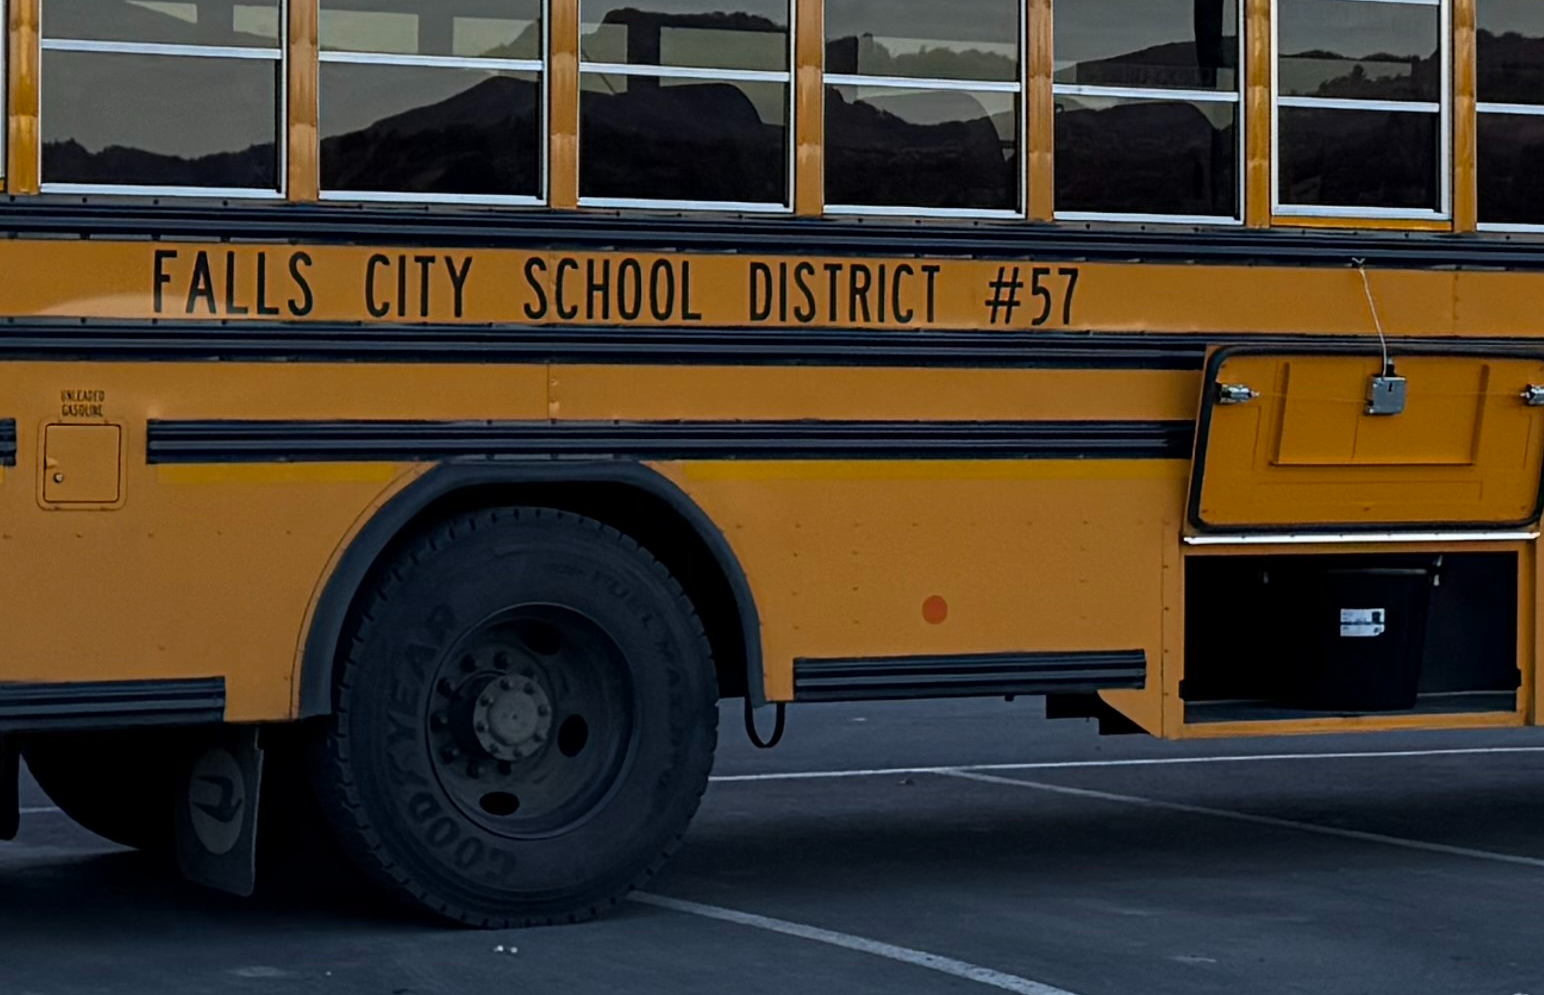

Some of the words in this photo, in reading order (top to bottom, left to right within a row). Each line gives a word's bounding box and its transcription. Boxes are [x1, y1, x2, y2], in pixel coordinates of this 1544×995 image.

[153, 248, 314, 317] FALLS
[364, 252, 473, 319] CITY
[523, 256, 702, 322] SCHOOL
[748, 261, 940, 323] DISTRICT
[984, 265, 1079, 326] #57
[60, 389, 105, 402] UNLEADED
[61, 403, 103, 417] GASOLINE
[385, 604, 516, 880] GOODYEAR
